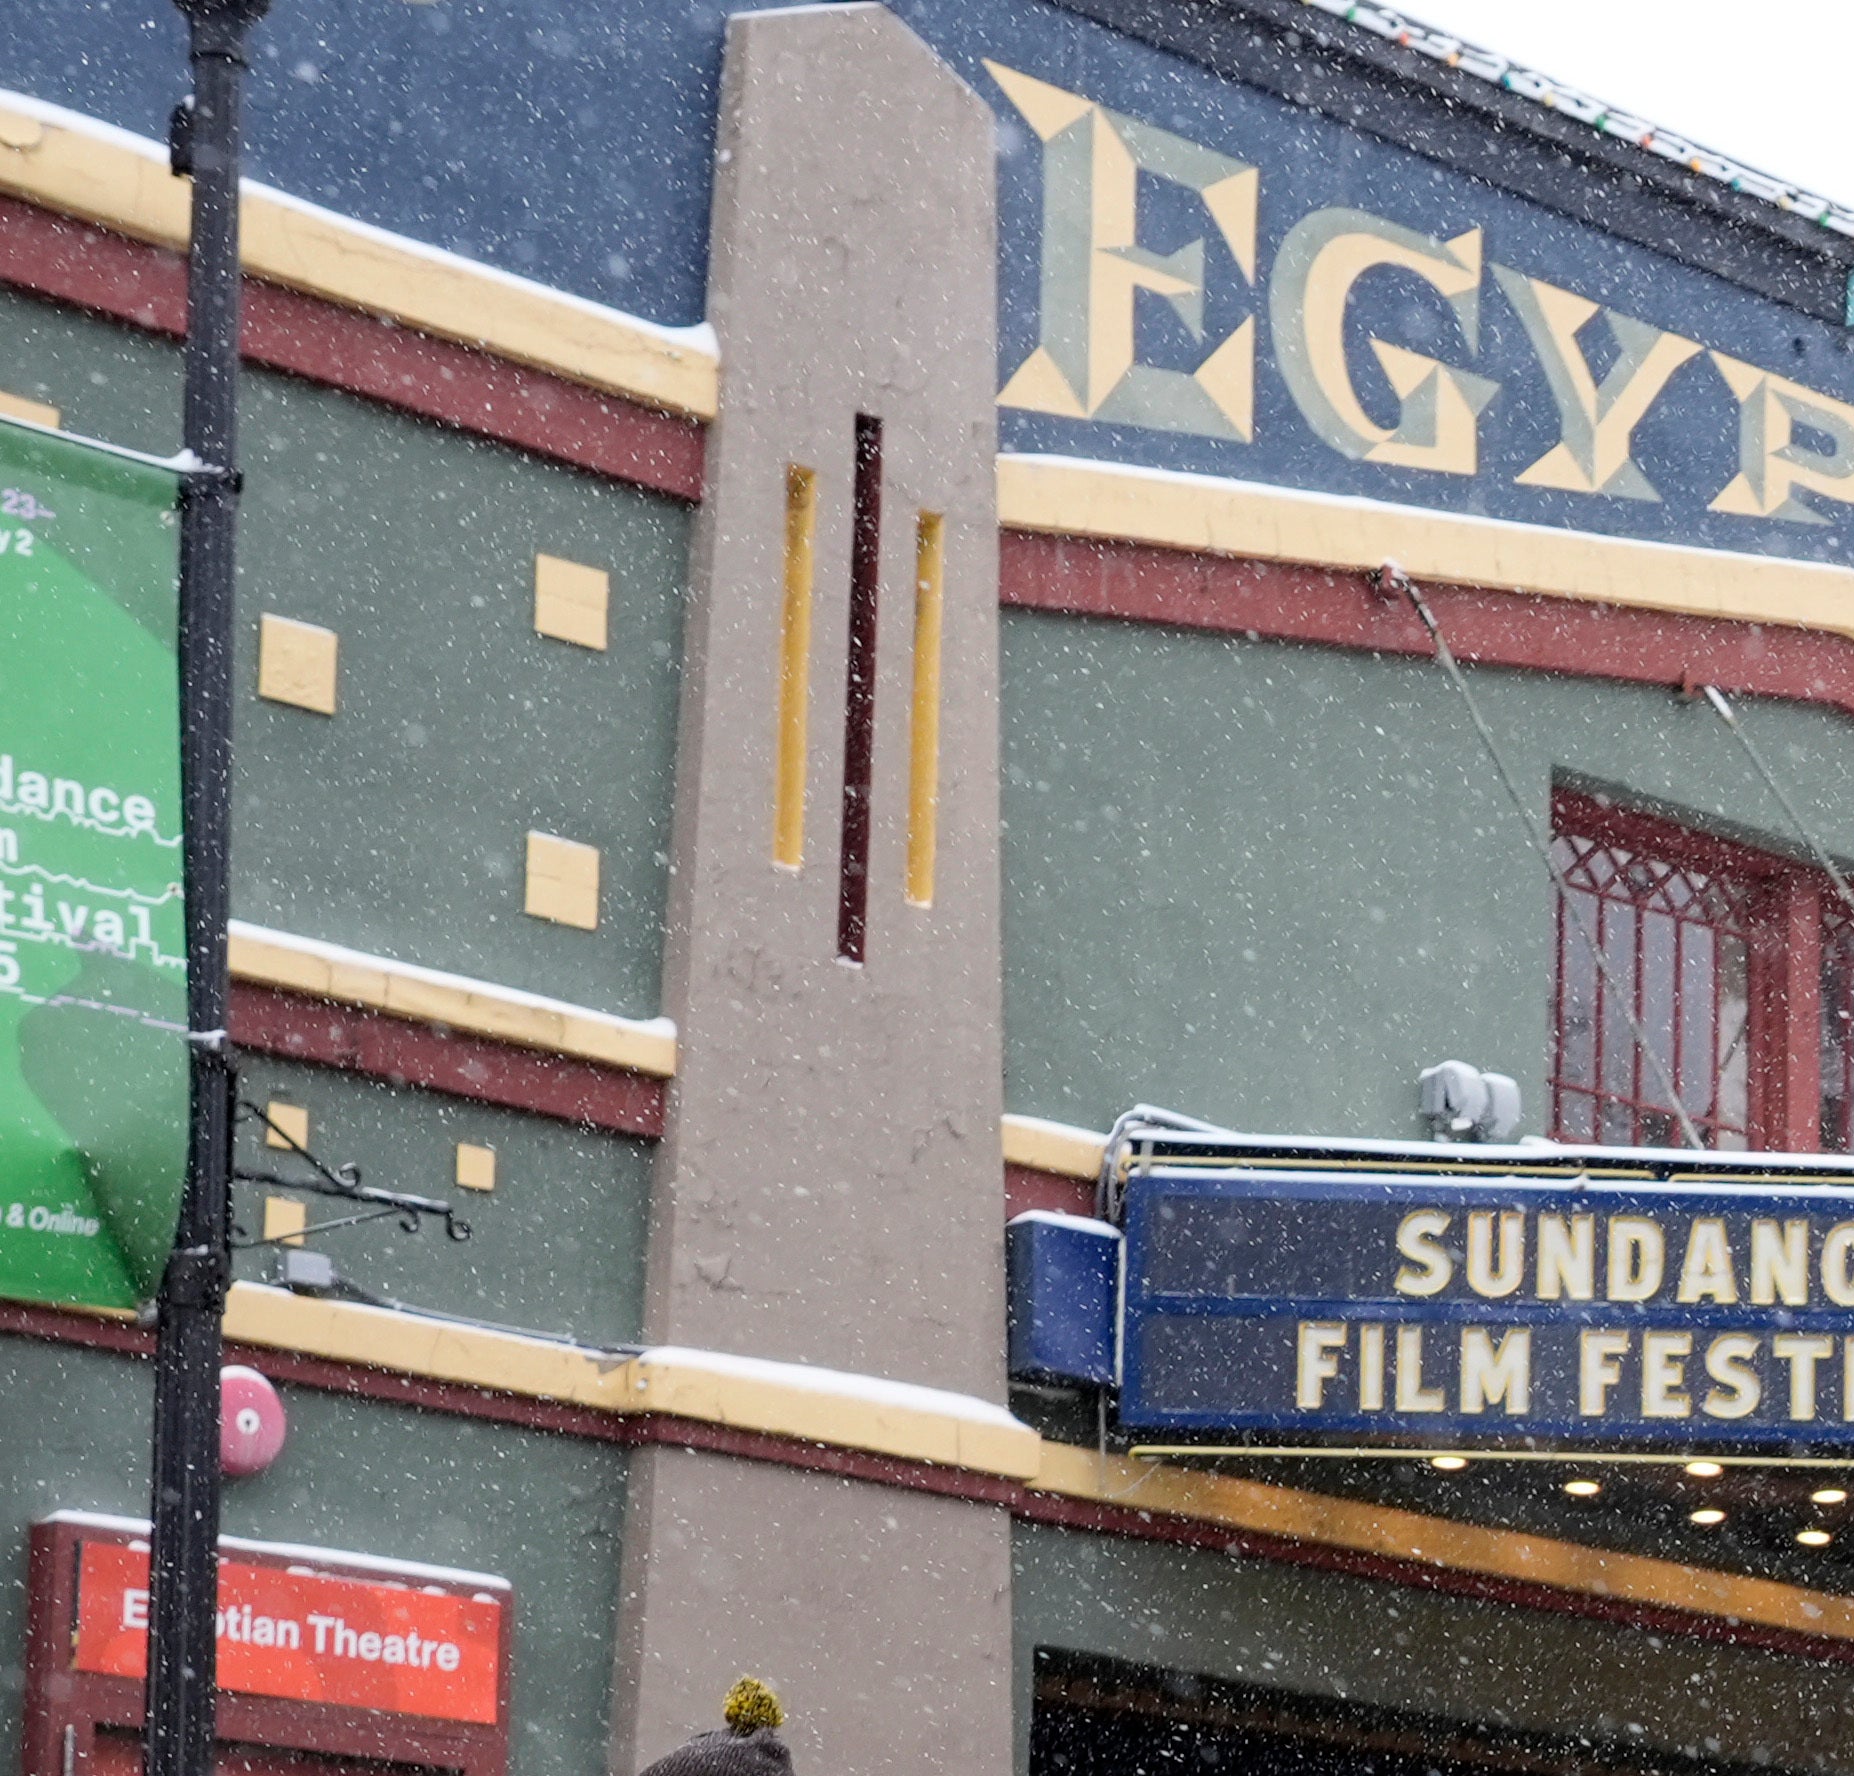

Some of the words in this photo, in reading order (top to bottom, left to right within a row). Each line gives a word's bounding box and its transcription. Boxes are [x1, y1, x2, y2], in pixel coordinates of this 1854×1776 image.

[5, 1202, 26, 1229] &
[28, 1205, 101, 1237] Online
[1295, 1320, 1534, 1416] FILM
[122, 1588, 300, 1651] Etian
[306, 1613, 461, 1673] Theatre
